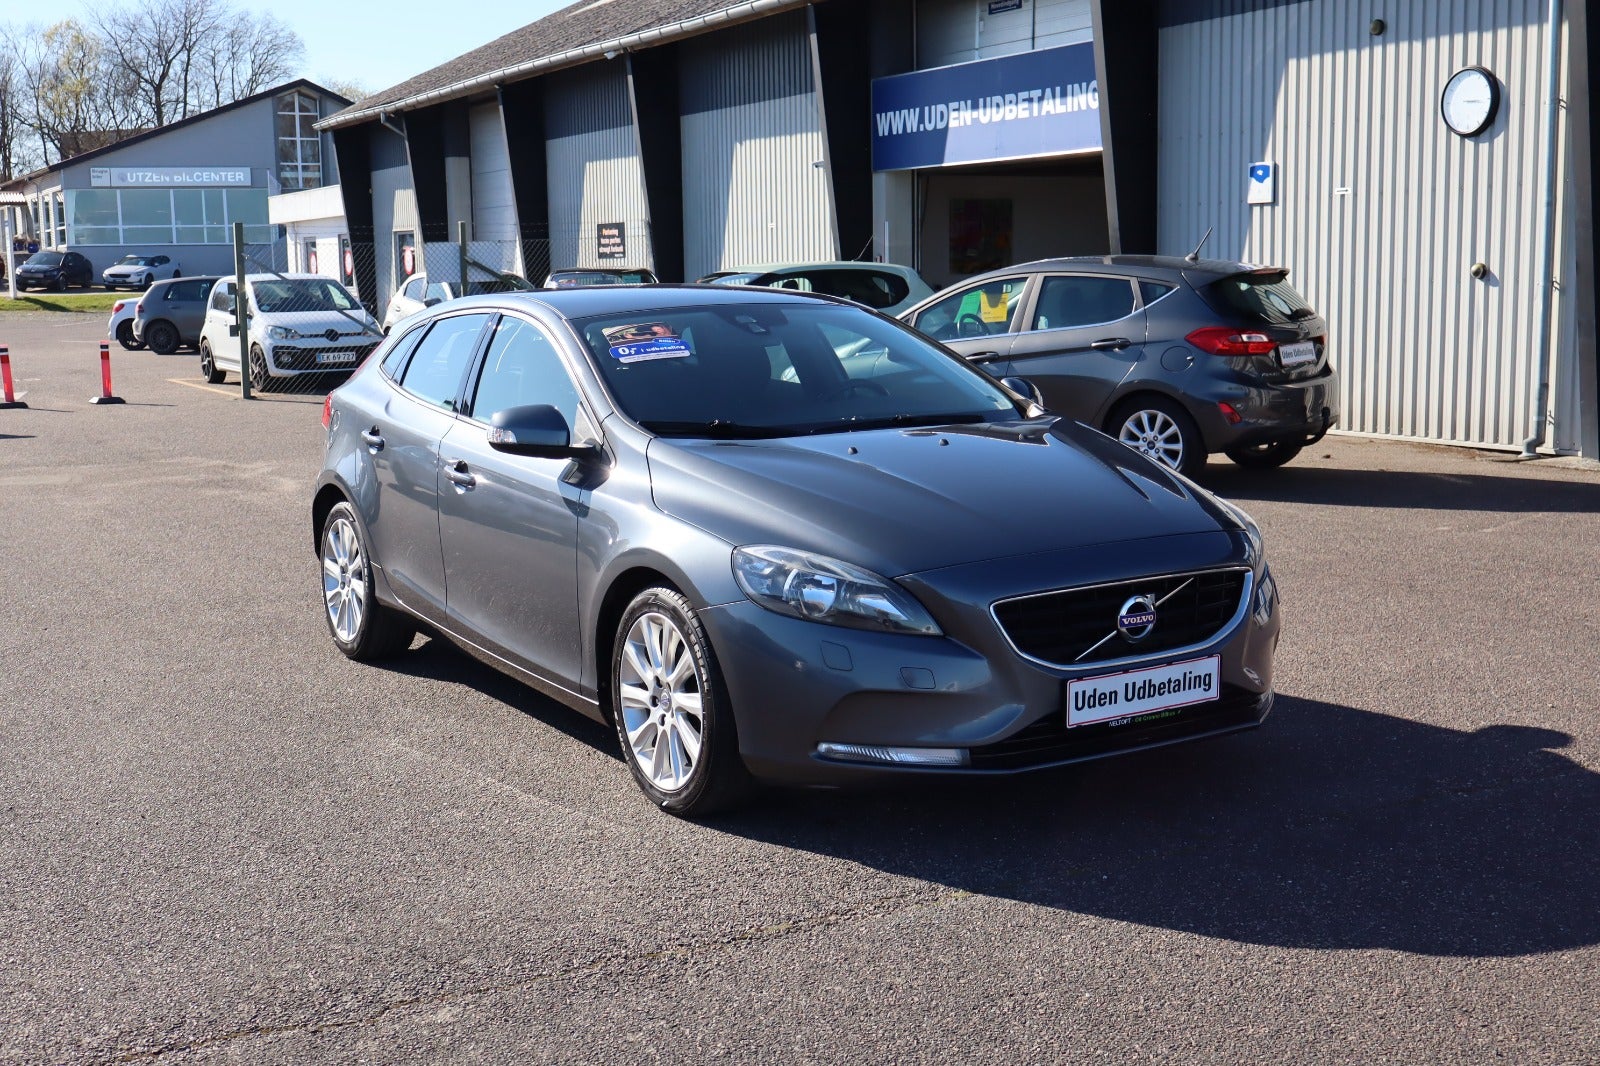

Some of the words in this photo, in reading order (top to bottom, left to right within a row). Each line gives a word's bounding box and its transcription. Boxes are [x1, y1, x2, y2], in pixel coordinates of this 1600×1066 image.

[876, 80, 1099, 137] WWW.UDEN-UDBETALING
[332, 353, 341, 361] 69
[1282, 350, 1294, 359] Uden
[1293, 346, 1315, 358] Udbetaling
[1122, 614, 1154, 625] VOLVO
[1074, 688, 1118, 711] Uden
[1124, 671, 1212, 702] Udbetaling
